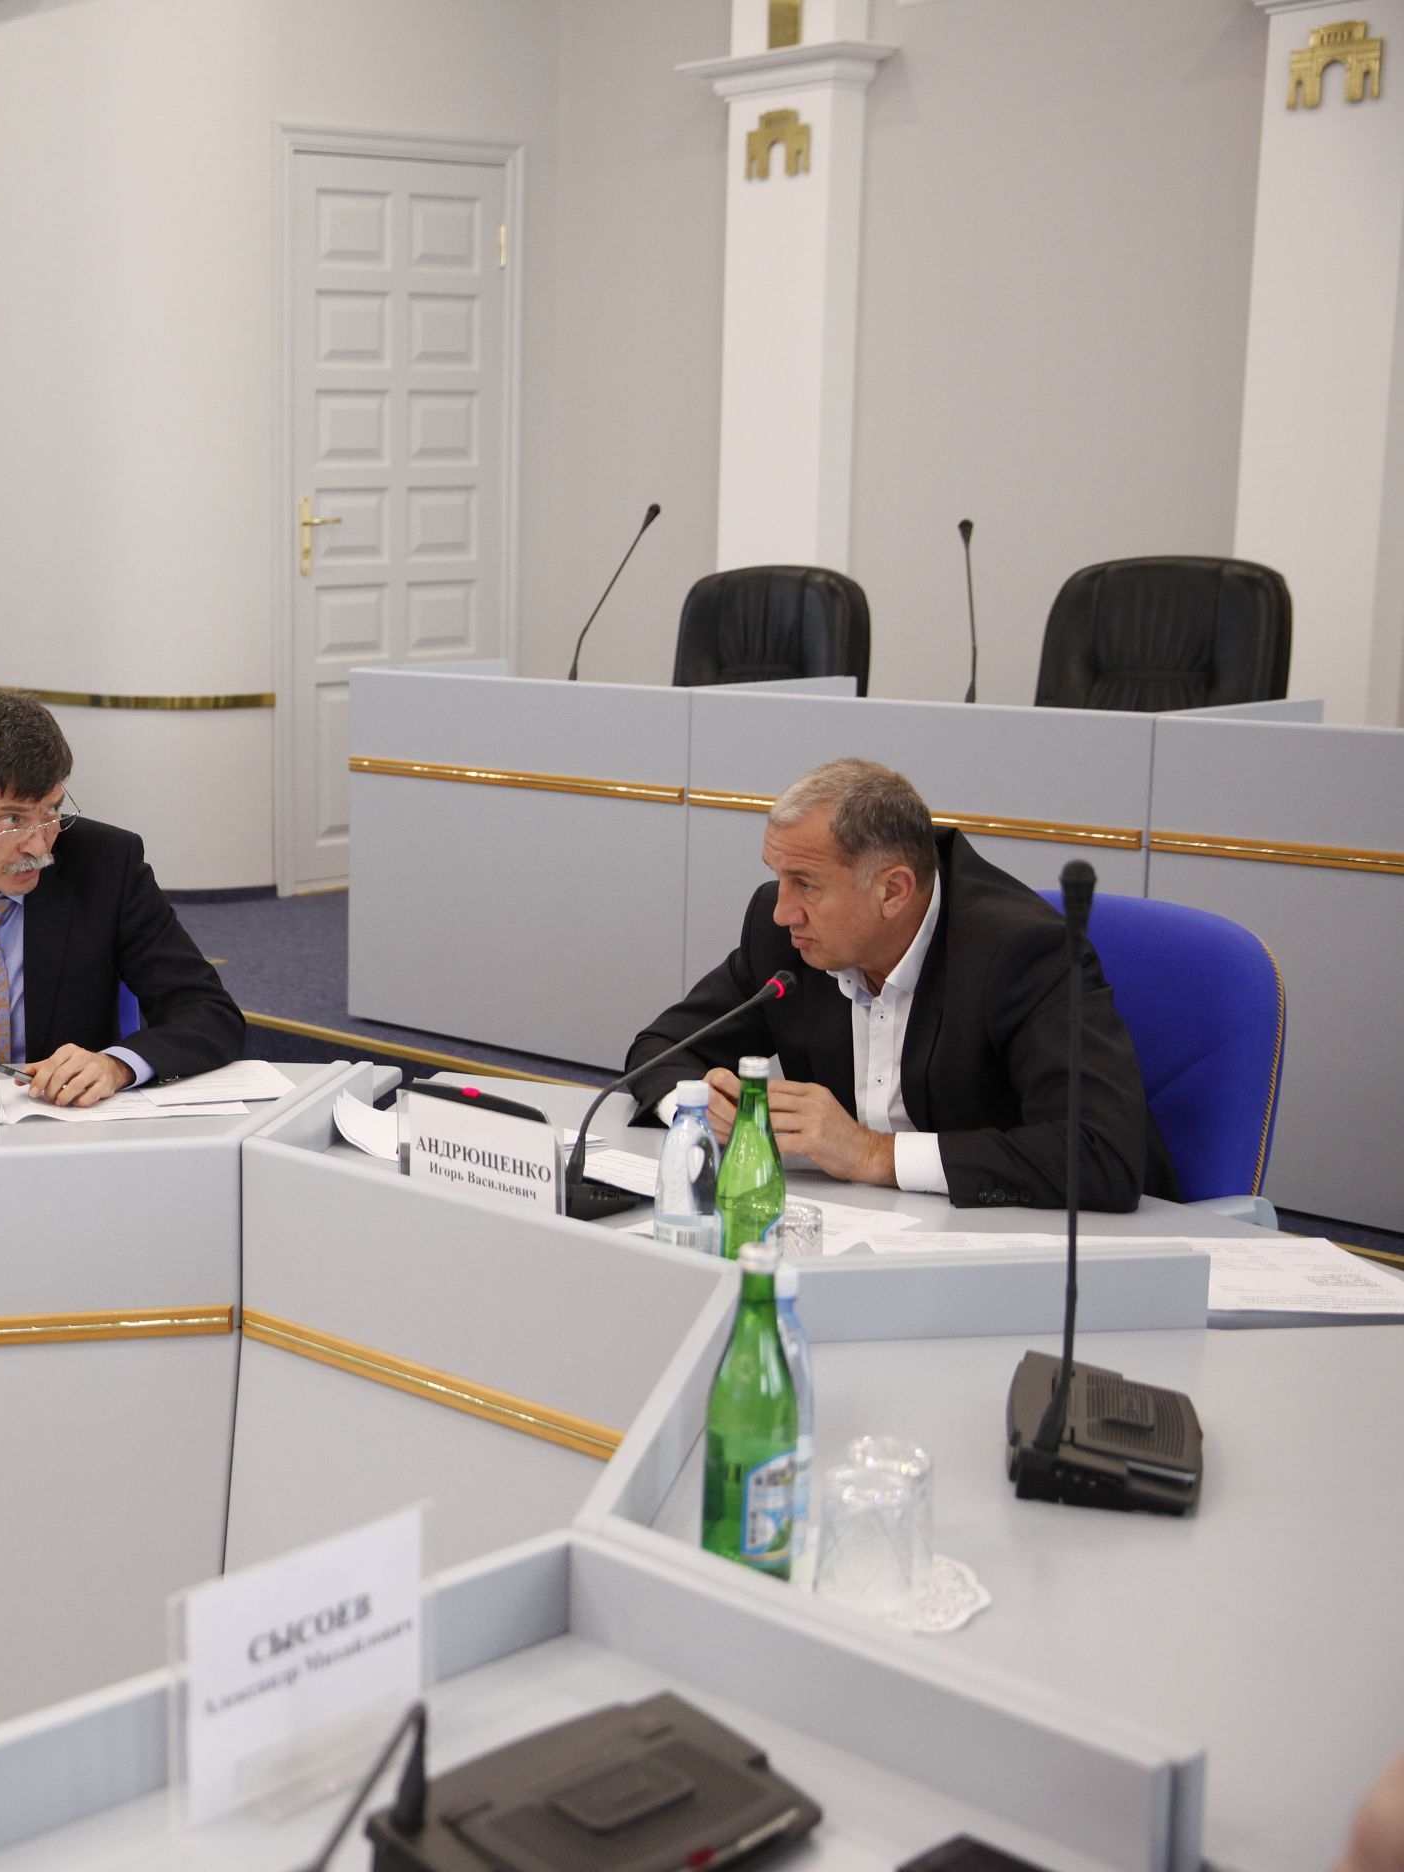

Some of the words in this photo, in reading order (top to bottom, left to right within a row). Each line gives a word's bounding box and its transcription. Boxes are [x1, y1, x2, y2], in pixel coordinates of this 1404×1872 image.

[416, 1135, 551, 1183] АНДРЮЩЕНКО
[429, 1161, 464, 1181] Игорь
[467, 1171, 537, 1200] Васильевич
[248, 1593, 371, 1663] СЫСОЕВ
